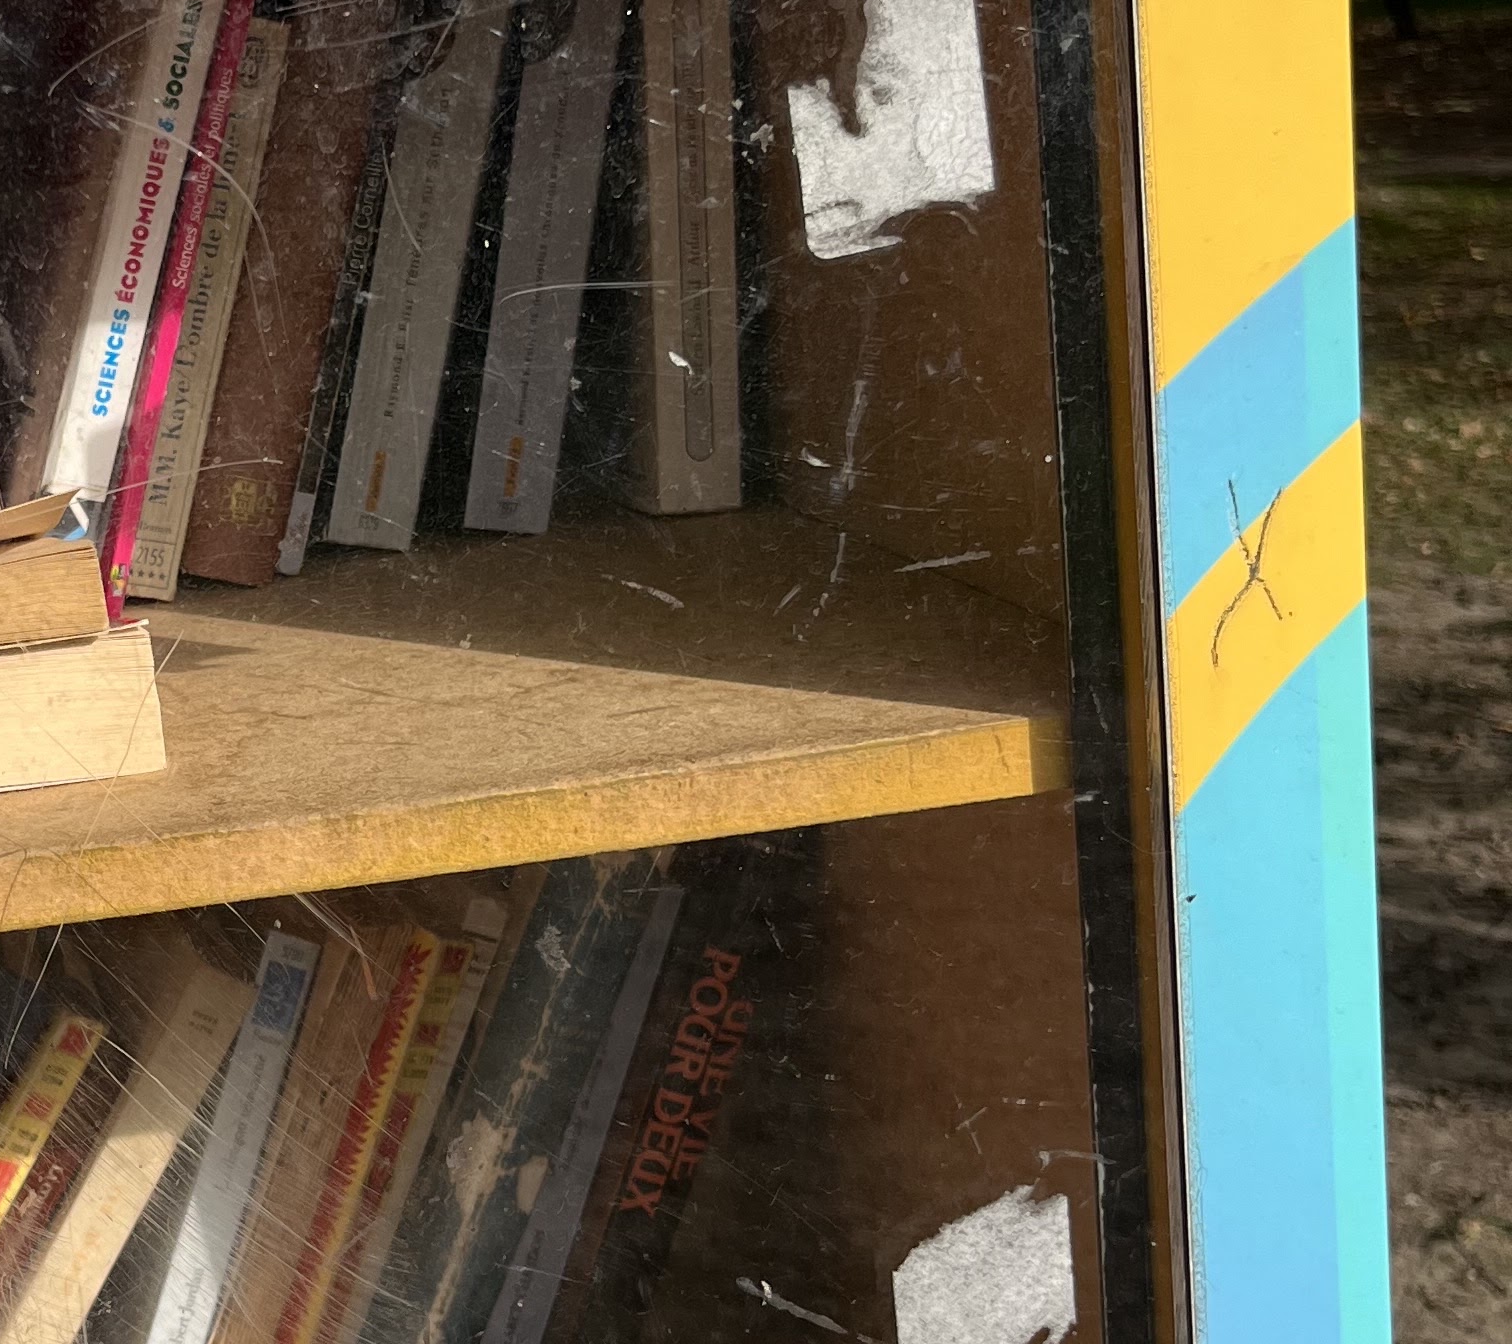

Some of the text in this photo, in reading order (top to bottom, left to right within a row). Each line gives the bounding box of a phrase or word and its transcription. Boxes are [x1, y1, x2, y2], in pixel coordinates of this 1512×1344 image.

[172, 67, 234, 290] Sciences sociales et politiques
[205, 198, 227, 223] la
[91, 308, 130, 418] SCIENCES
[115, 135, 172, 305] ÉCONOMIQUES
[158, 116, 176, 134] &
[202, 228, 223, 259] de
[342, 233, 368, 286] Pierre
[148, 450, 177, 506] M.M.
[137, 546, 165, 567] 2155
[618, 944, 741, 1218] POUR DEUX
[672, 999, 754, 1181] UNE VIE
